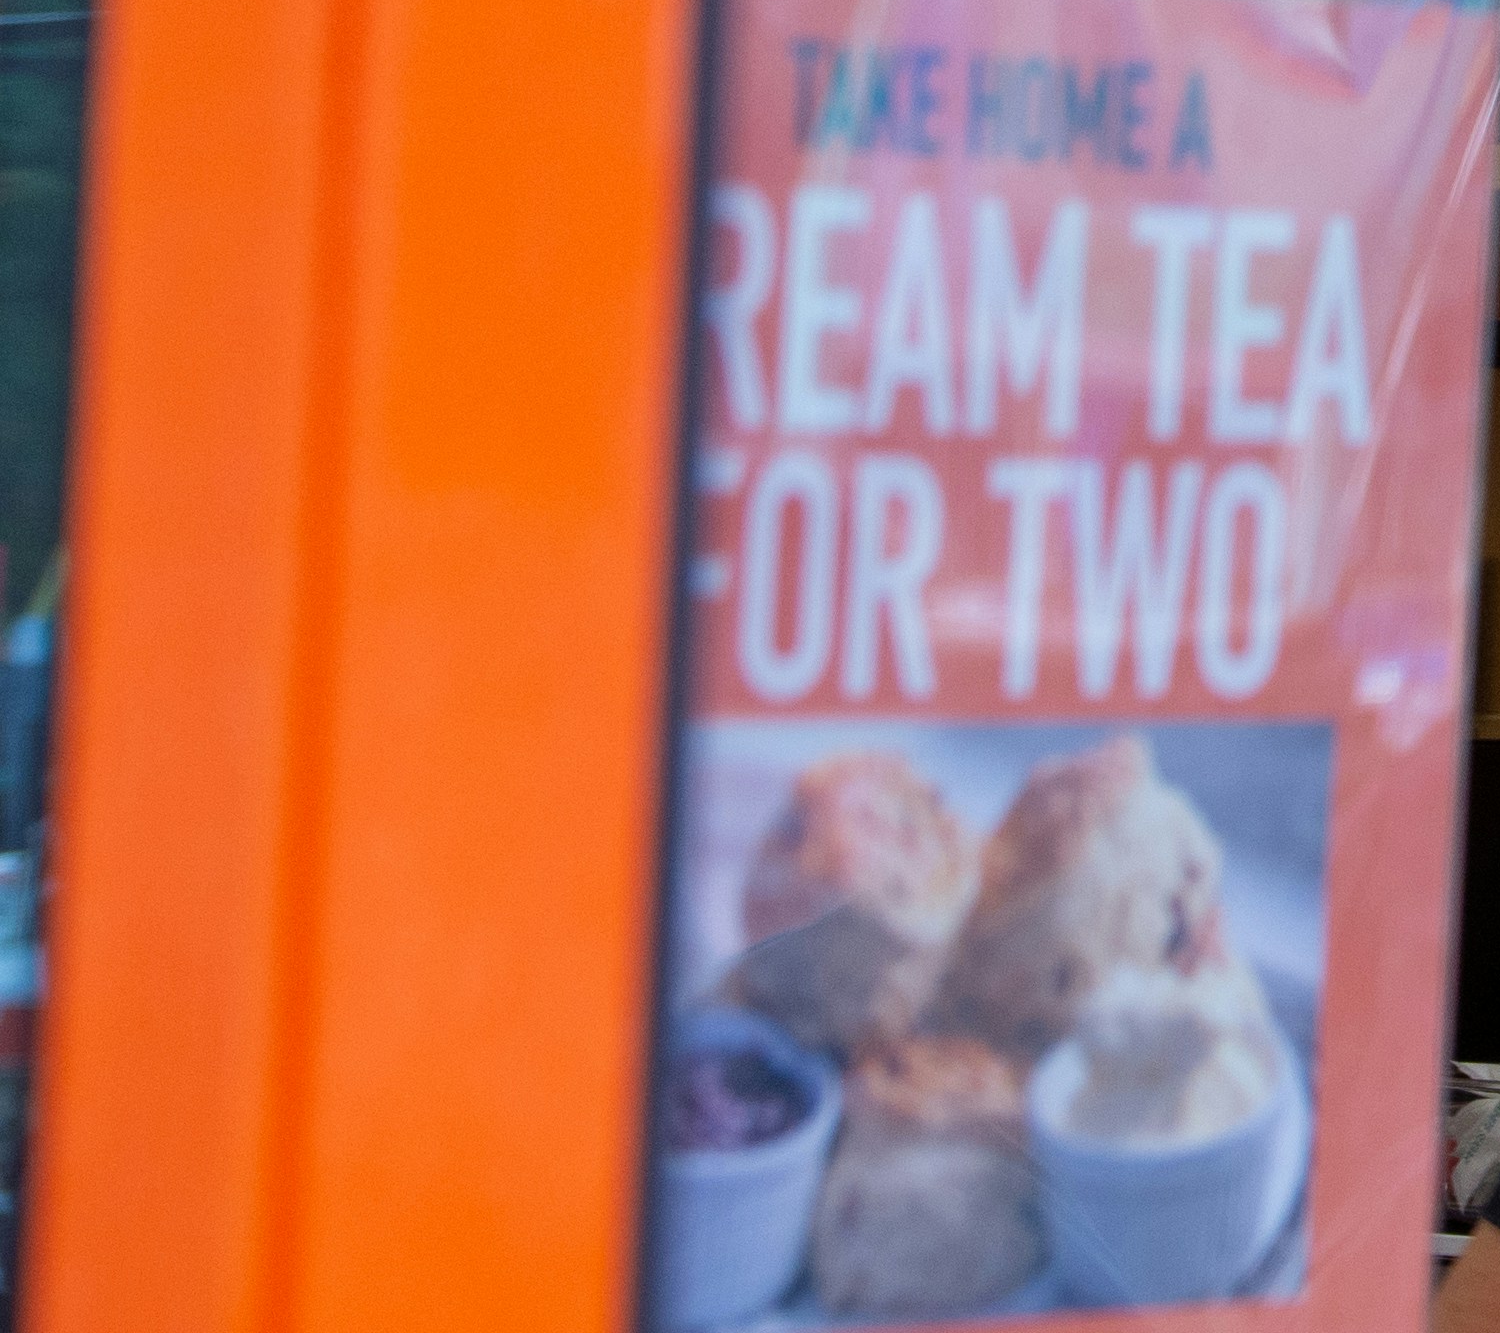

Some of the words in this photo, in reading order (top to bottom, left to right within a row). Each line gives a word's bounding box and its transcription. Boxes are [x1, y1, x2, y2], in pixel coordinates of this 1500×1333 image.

[693, 185, 1084, 443] REAM
[1130, 209, 1373, 448] TEA
[988, 456, 1290, 702] TWO
